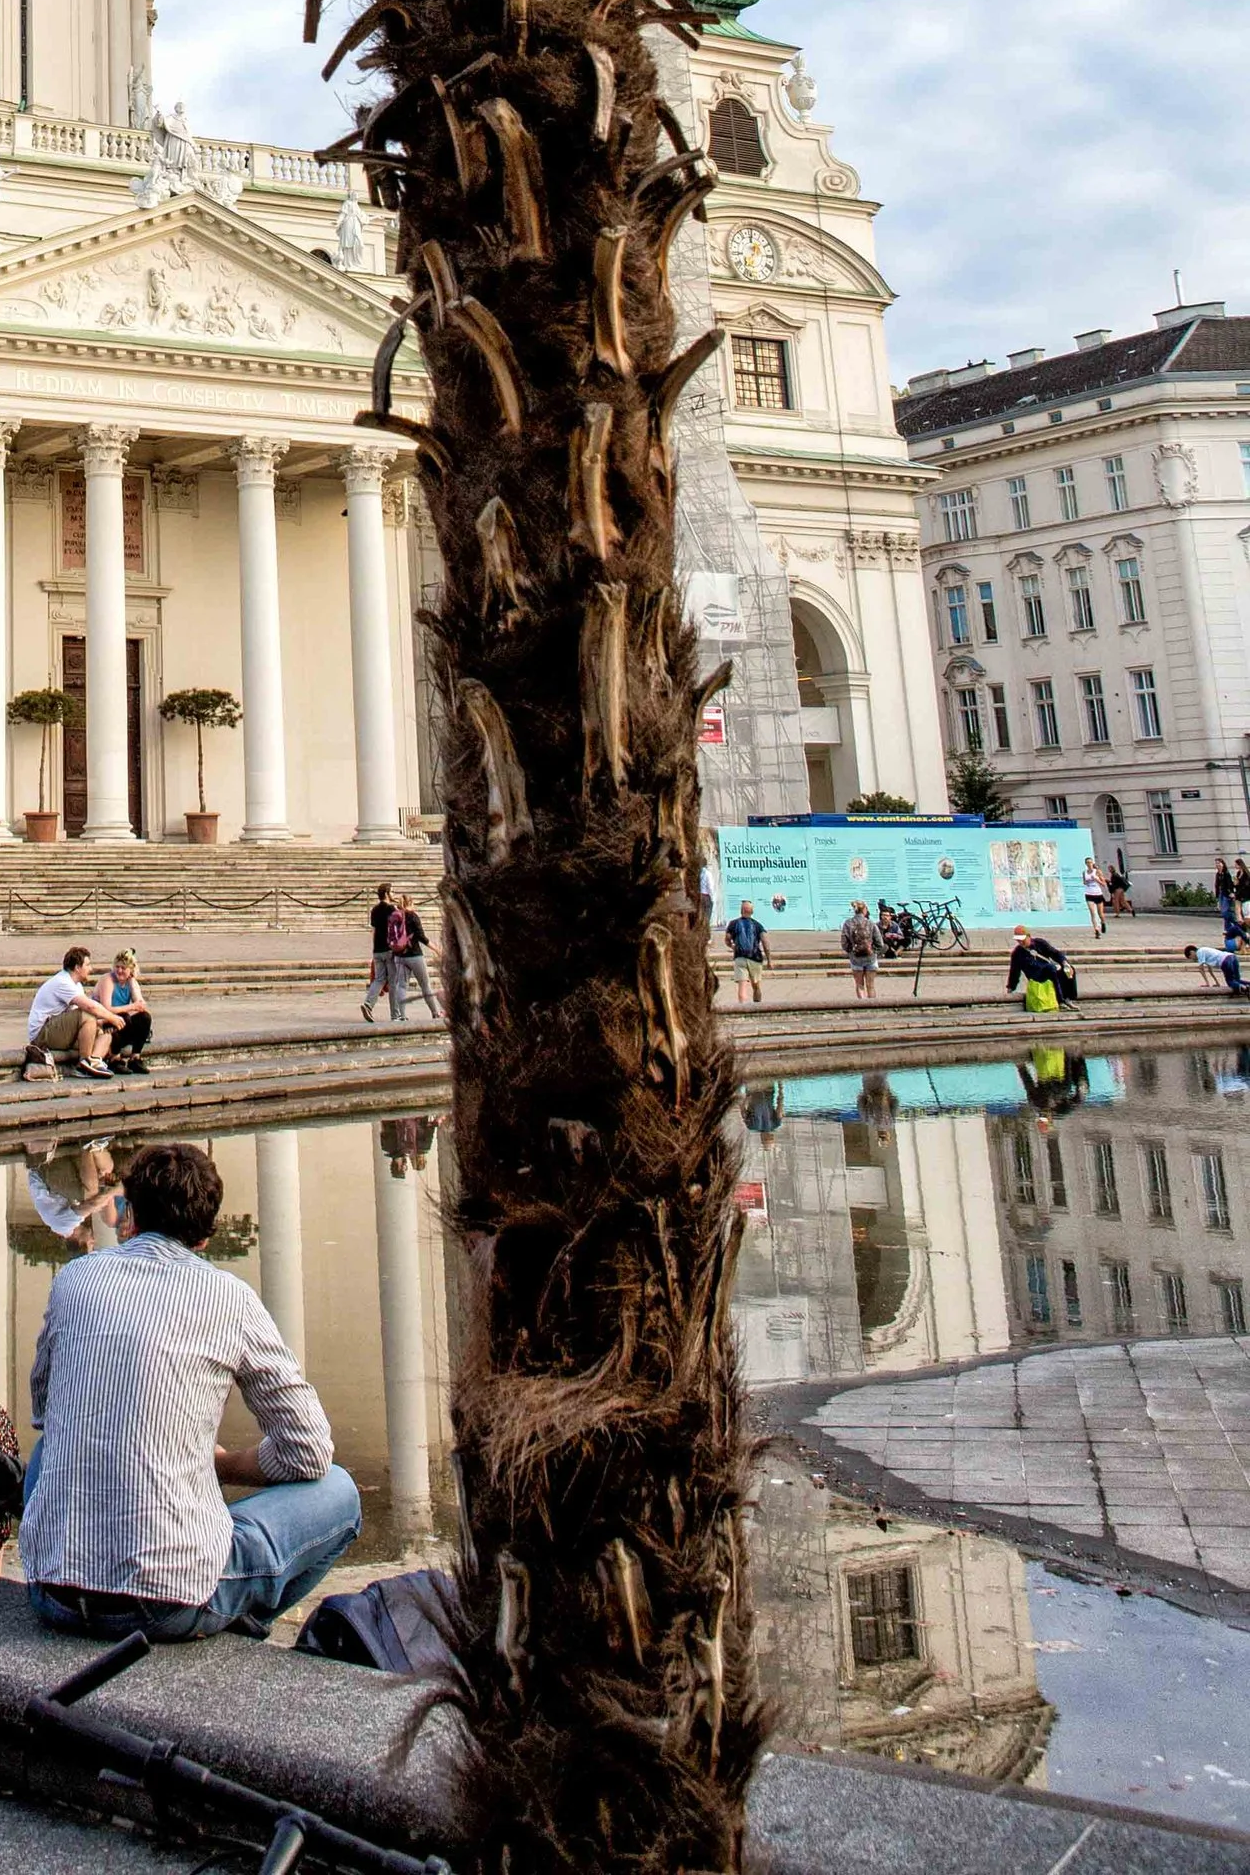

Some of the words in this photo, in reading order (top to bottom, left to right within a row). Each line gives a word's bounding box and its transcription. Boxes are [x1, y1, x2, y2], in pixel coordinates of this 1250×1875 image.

[16, 369, 102, 396] REDDAM
[117, 379, 137, 401] IN
[846, 815, 954, 823] www.containex.com
[814, 837, 837, 847] Projekt
[904, 837, 943, 846] Maßnahmen
[723, 842, 781, 855] Karlskirche
[725, 856, 808, 871] Triumphsäulen
[726, 875, 772, 885] Restaurierung
